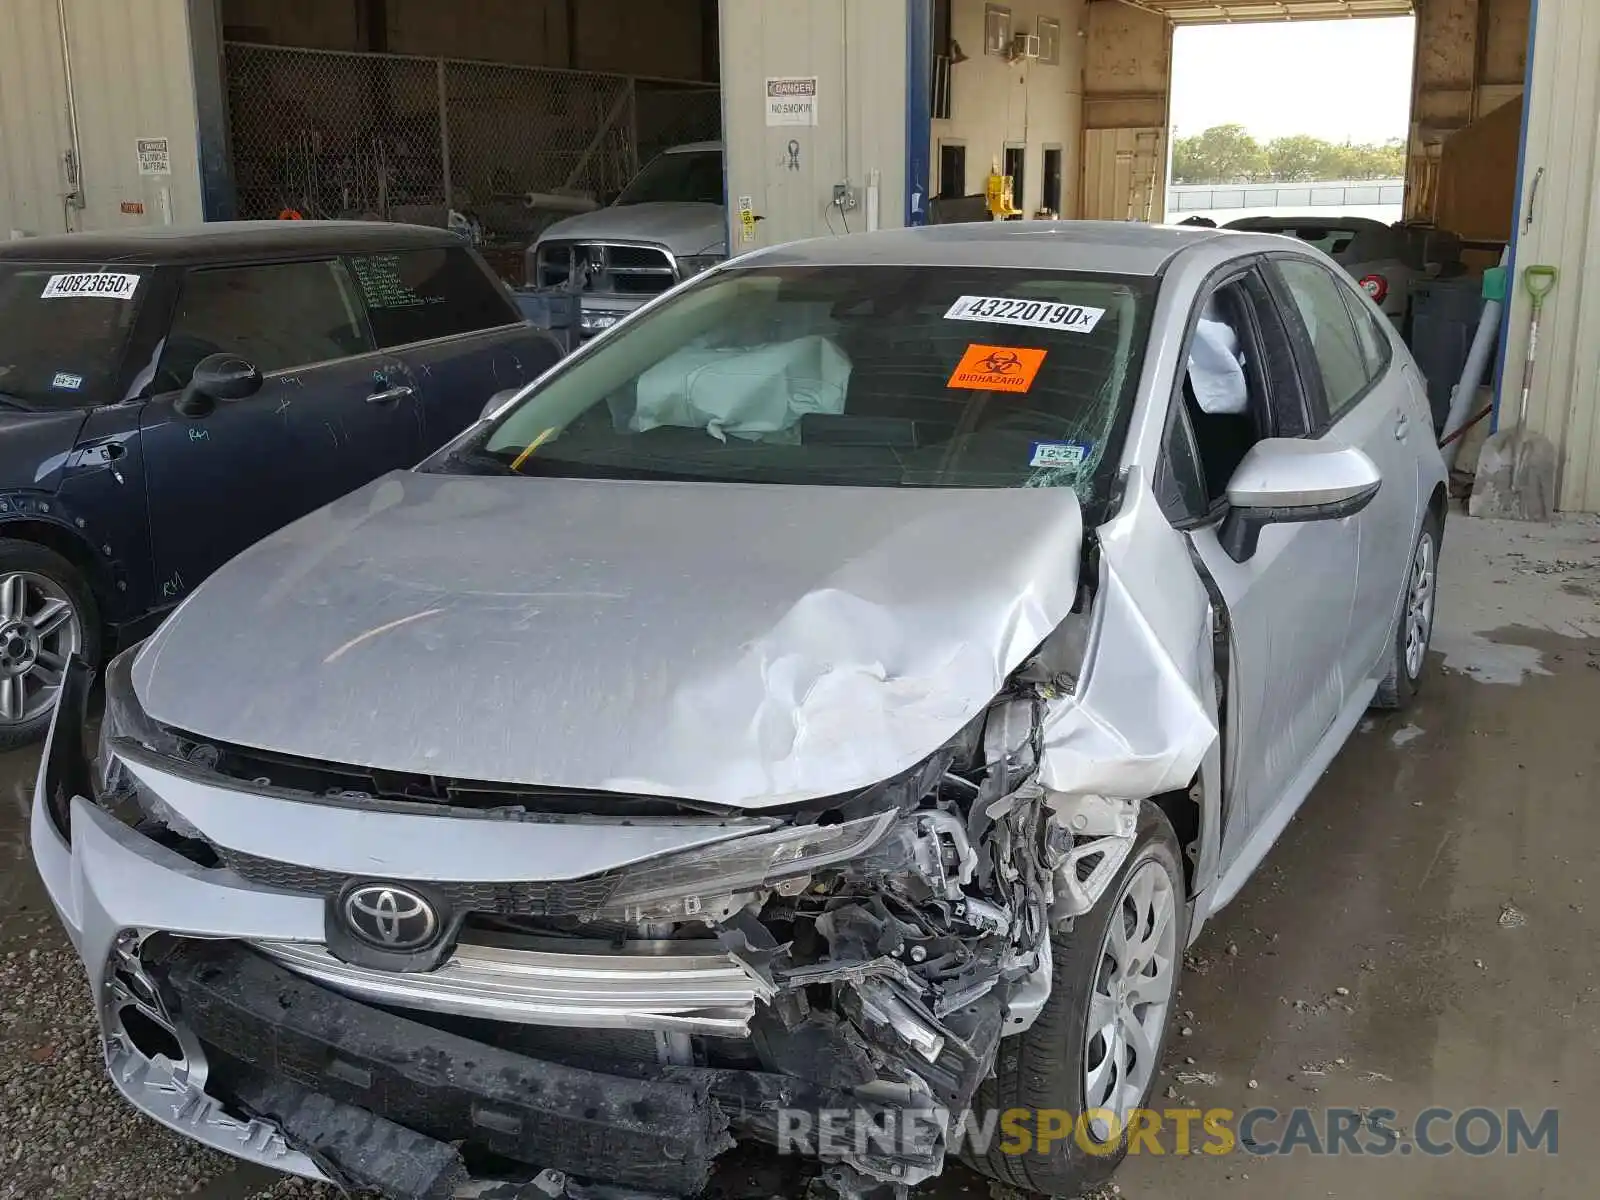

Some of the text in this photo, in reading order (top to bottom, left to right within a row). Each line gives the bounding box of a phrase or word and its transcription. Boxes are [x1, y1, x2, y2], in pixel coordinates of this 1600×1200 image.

[775, 83, 813, 94] DANGER
[771, 103, 813, 113] NO SMOKIN
[957, 373, 1025, 385] BIOHAZARD
[1040, 449, 1055, 458] 12
